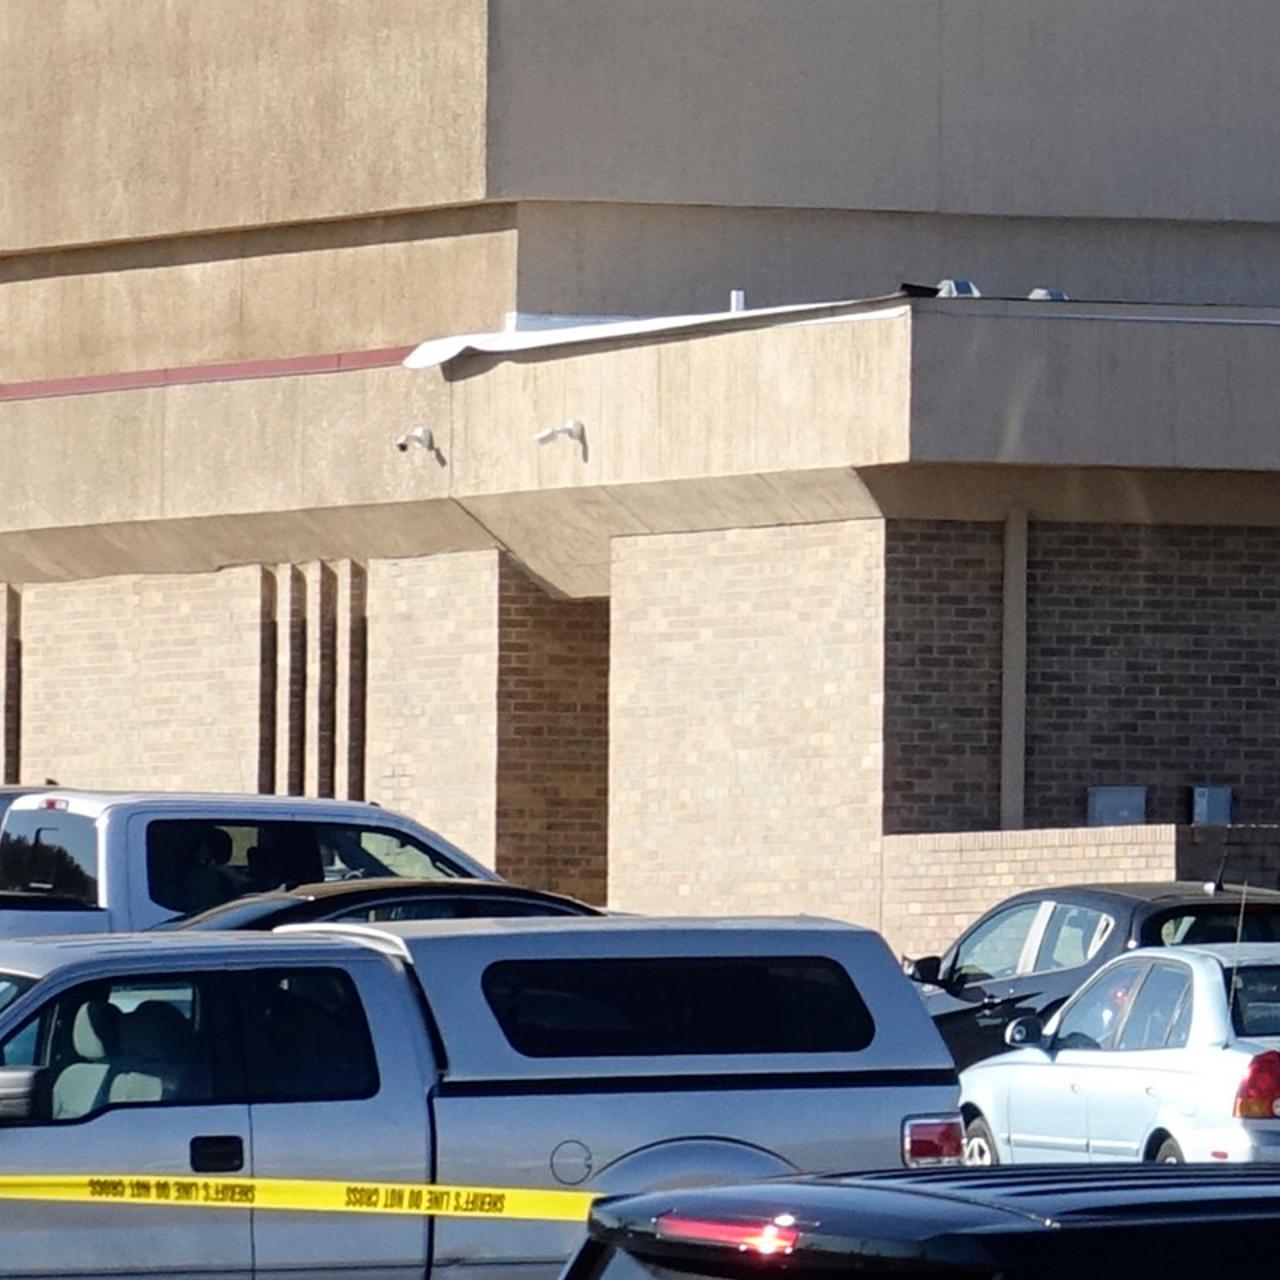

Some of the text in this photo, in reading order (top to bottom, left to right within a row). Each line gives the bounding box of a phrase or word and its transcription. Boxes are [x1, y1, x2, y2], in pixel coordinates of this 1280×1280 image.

[173, 1181, 198, 1201] LINE
[345, 1187, 507, 1214] SHERIFF'S LINE DO NOT CROSS
